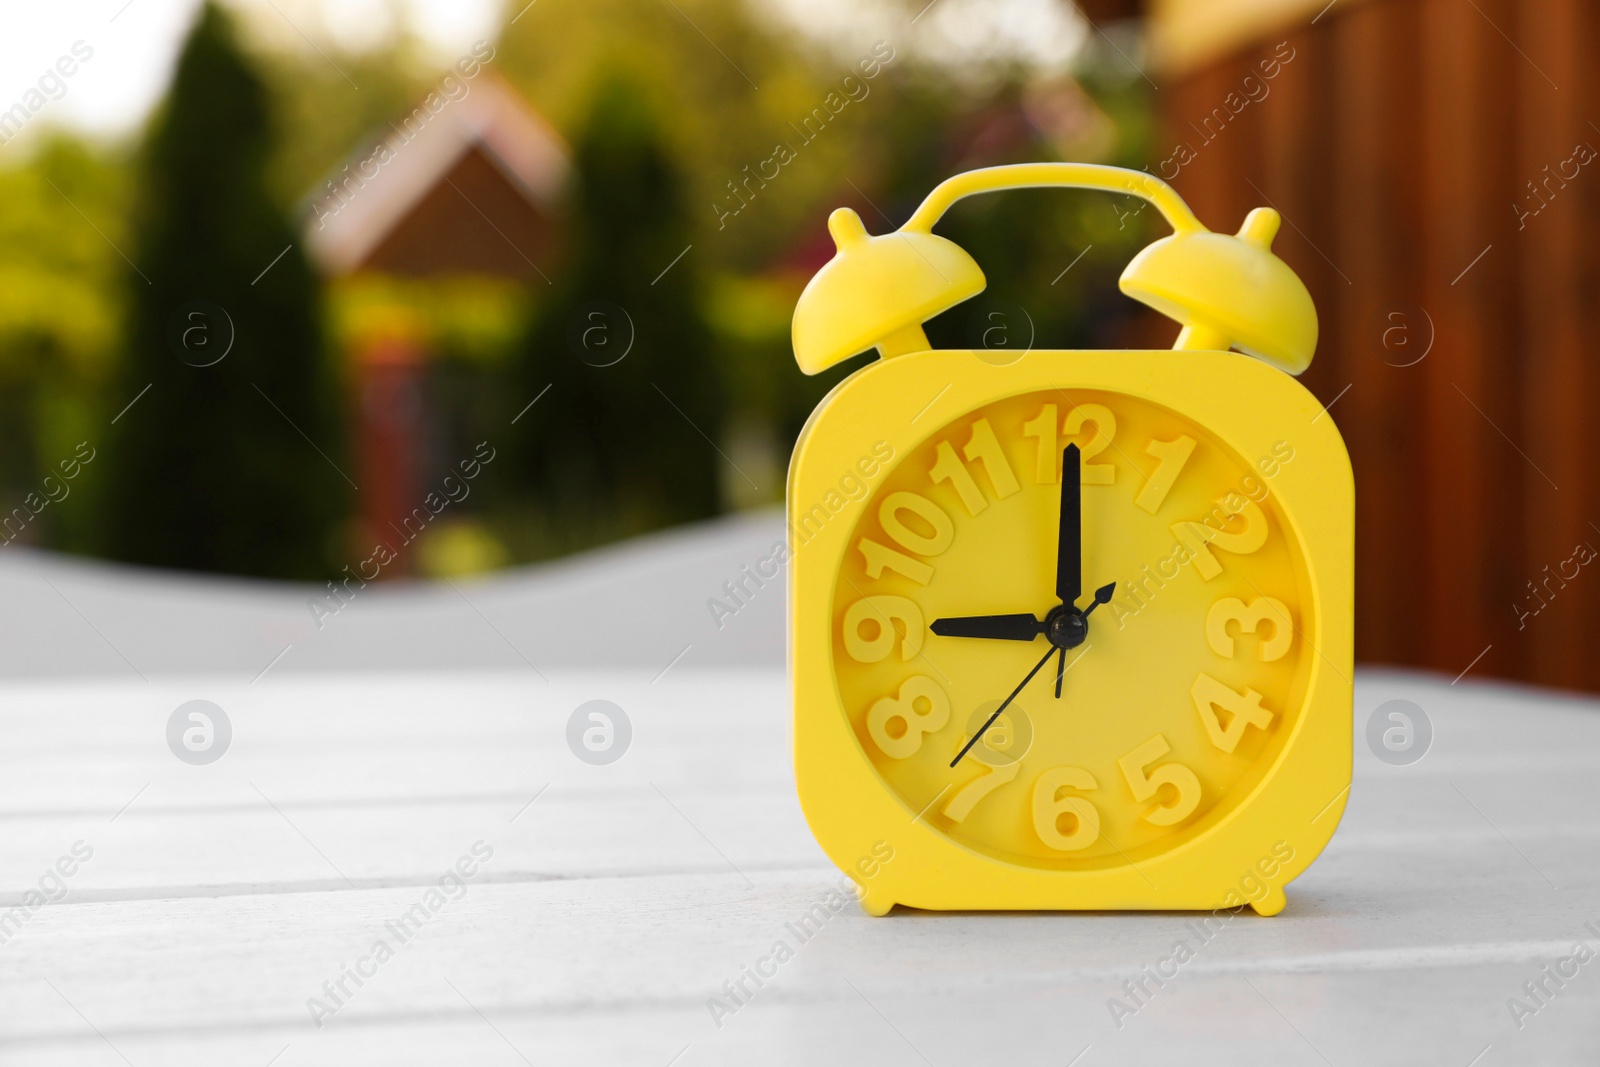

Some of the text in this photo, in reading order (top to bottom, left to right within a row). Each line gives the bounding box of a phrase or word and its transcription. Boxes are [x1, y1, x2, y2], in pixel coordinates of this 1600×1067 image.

[929, 417, 1022, 518] 11
[1023, 403, 1116, 485] 12
[1133, 434, 1197, 515] 1
[857, 491, 954, 586] 10
[1169, 491, 1268, 582] 2
[843, 595, 925, 663] 9
[1205, 597, 1293, 662] 3
[867, 675, 950, 760] 8
[1190, 672, 1274, 754] 4
[943, 734, 1021, 823] 7
[1032, 766, 1100, 851] 6
[1118, 733, 1201, 826] 5
